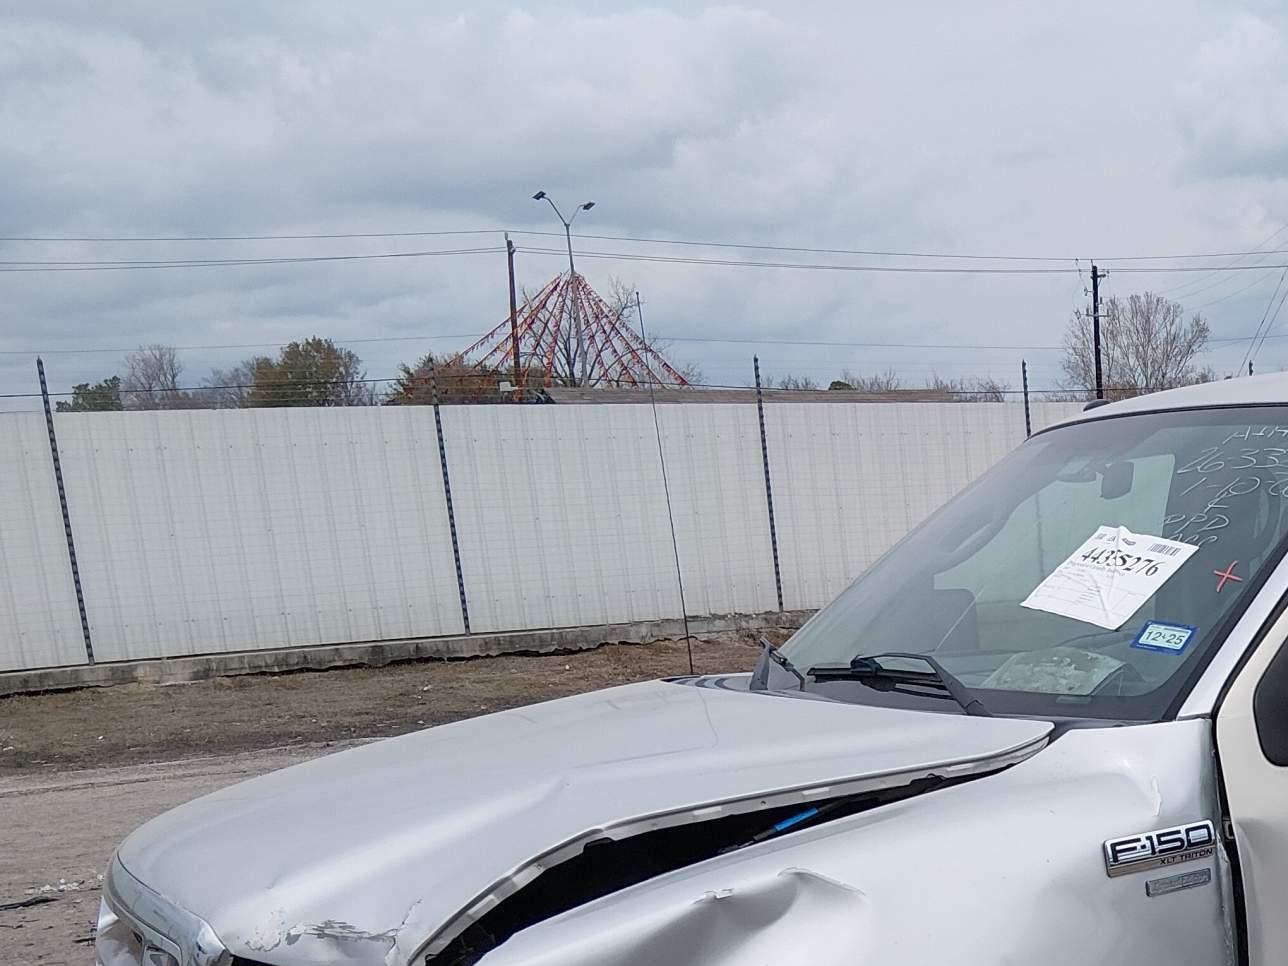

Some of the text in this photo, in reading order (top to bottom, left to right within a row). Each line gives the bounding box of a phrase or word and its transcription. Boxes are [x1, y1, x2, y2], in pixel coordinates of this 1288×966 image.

[1145, 631, 1163, 642] 12
[1166, 633, 1185, 645] 25
[1159, 848, 1213, 866] XLT TRITON
